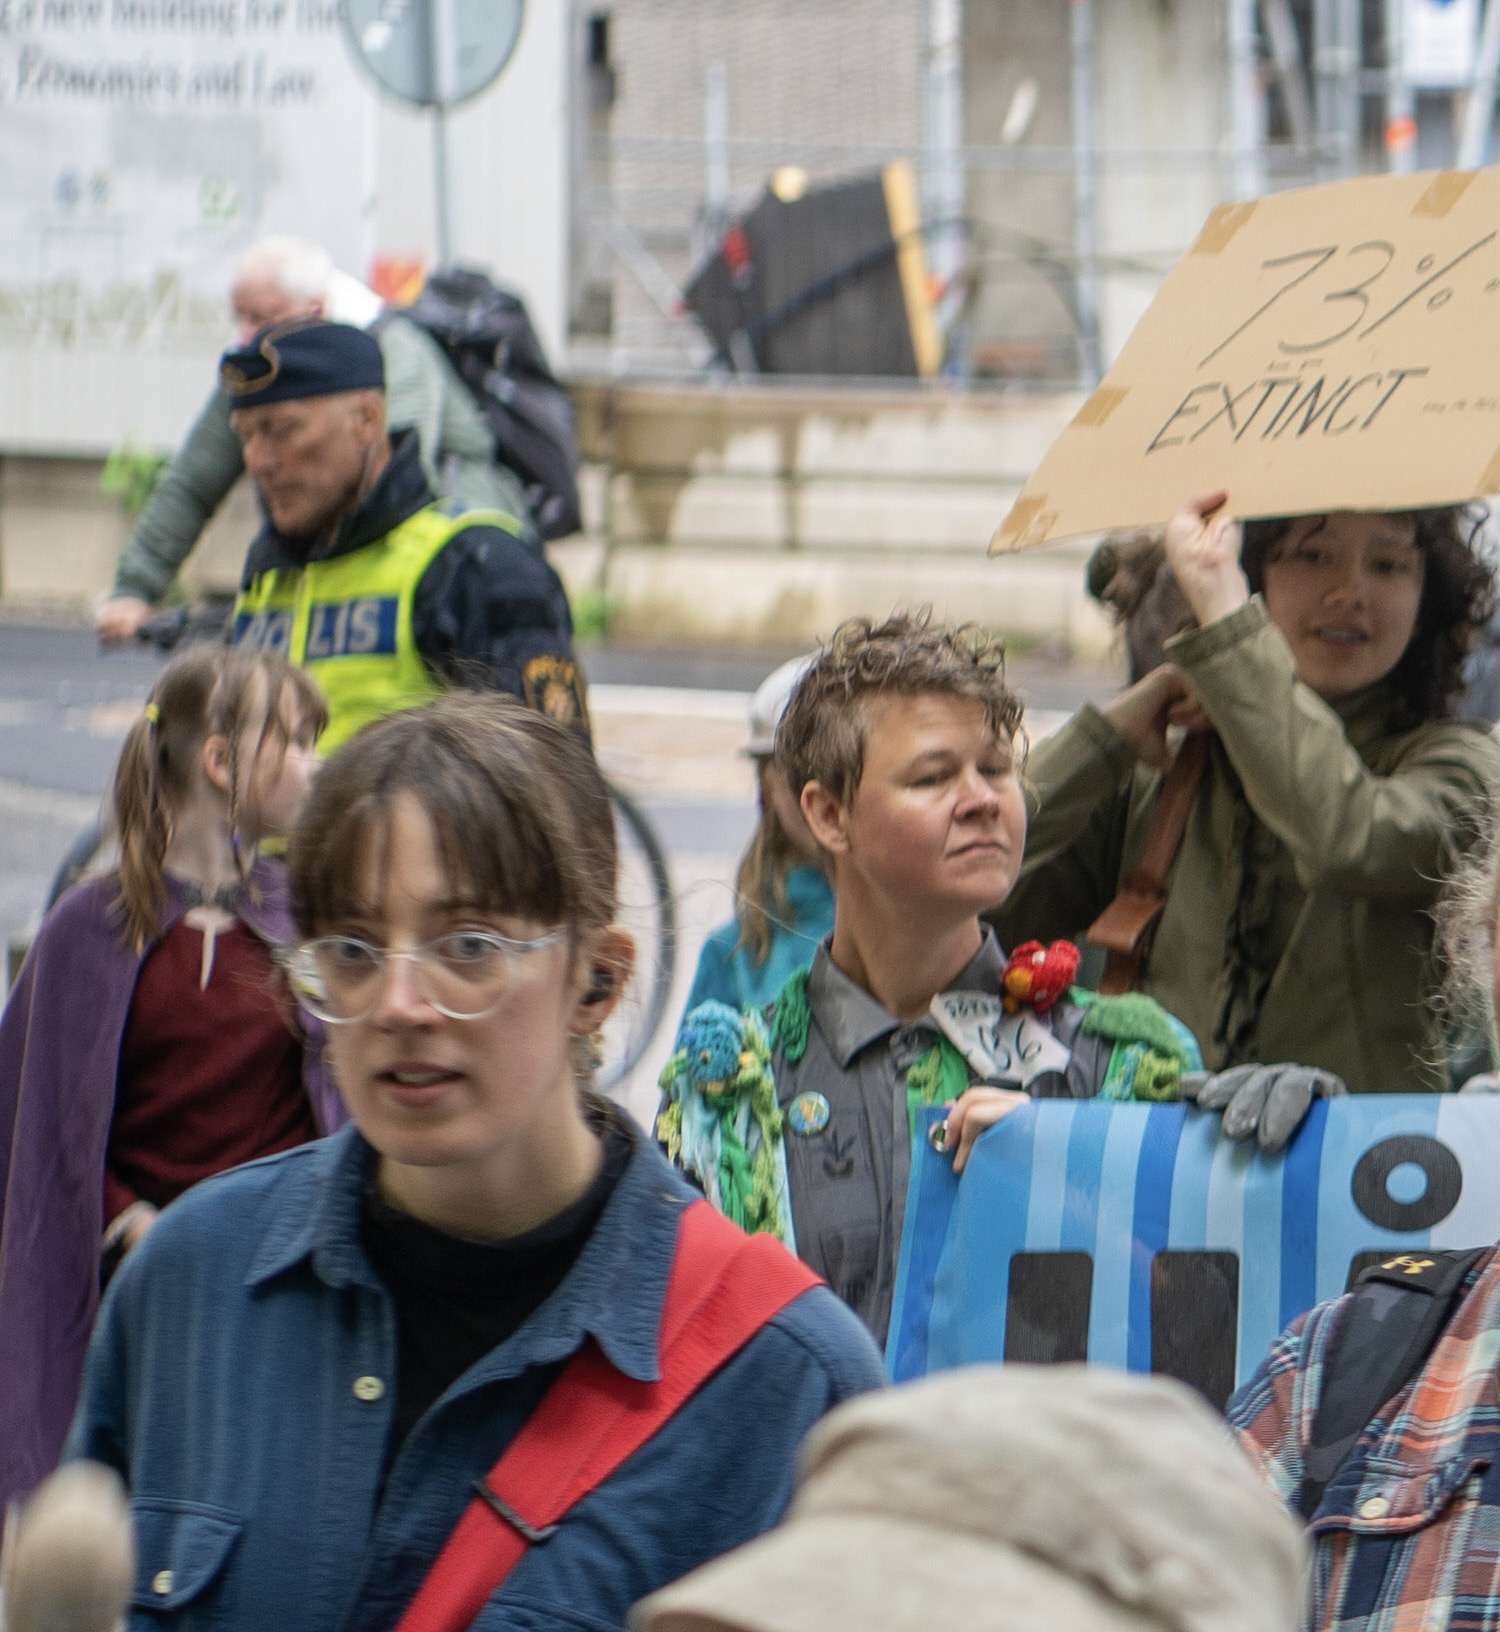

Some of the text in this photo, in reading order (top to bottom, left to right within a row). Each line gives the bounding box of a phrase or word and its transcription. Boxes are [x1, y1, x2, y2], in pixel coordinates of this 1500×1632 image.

[1195, 231, 1498, 370] 73%
[1145, 367, 1430, 456] EXTINCT
[236, 597, 380, 657] POLIS
